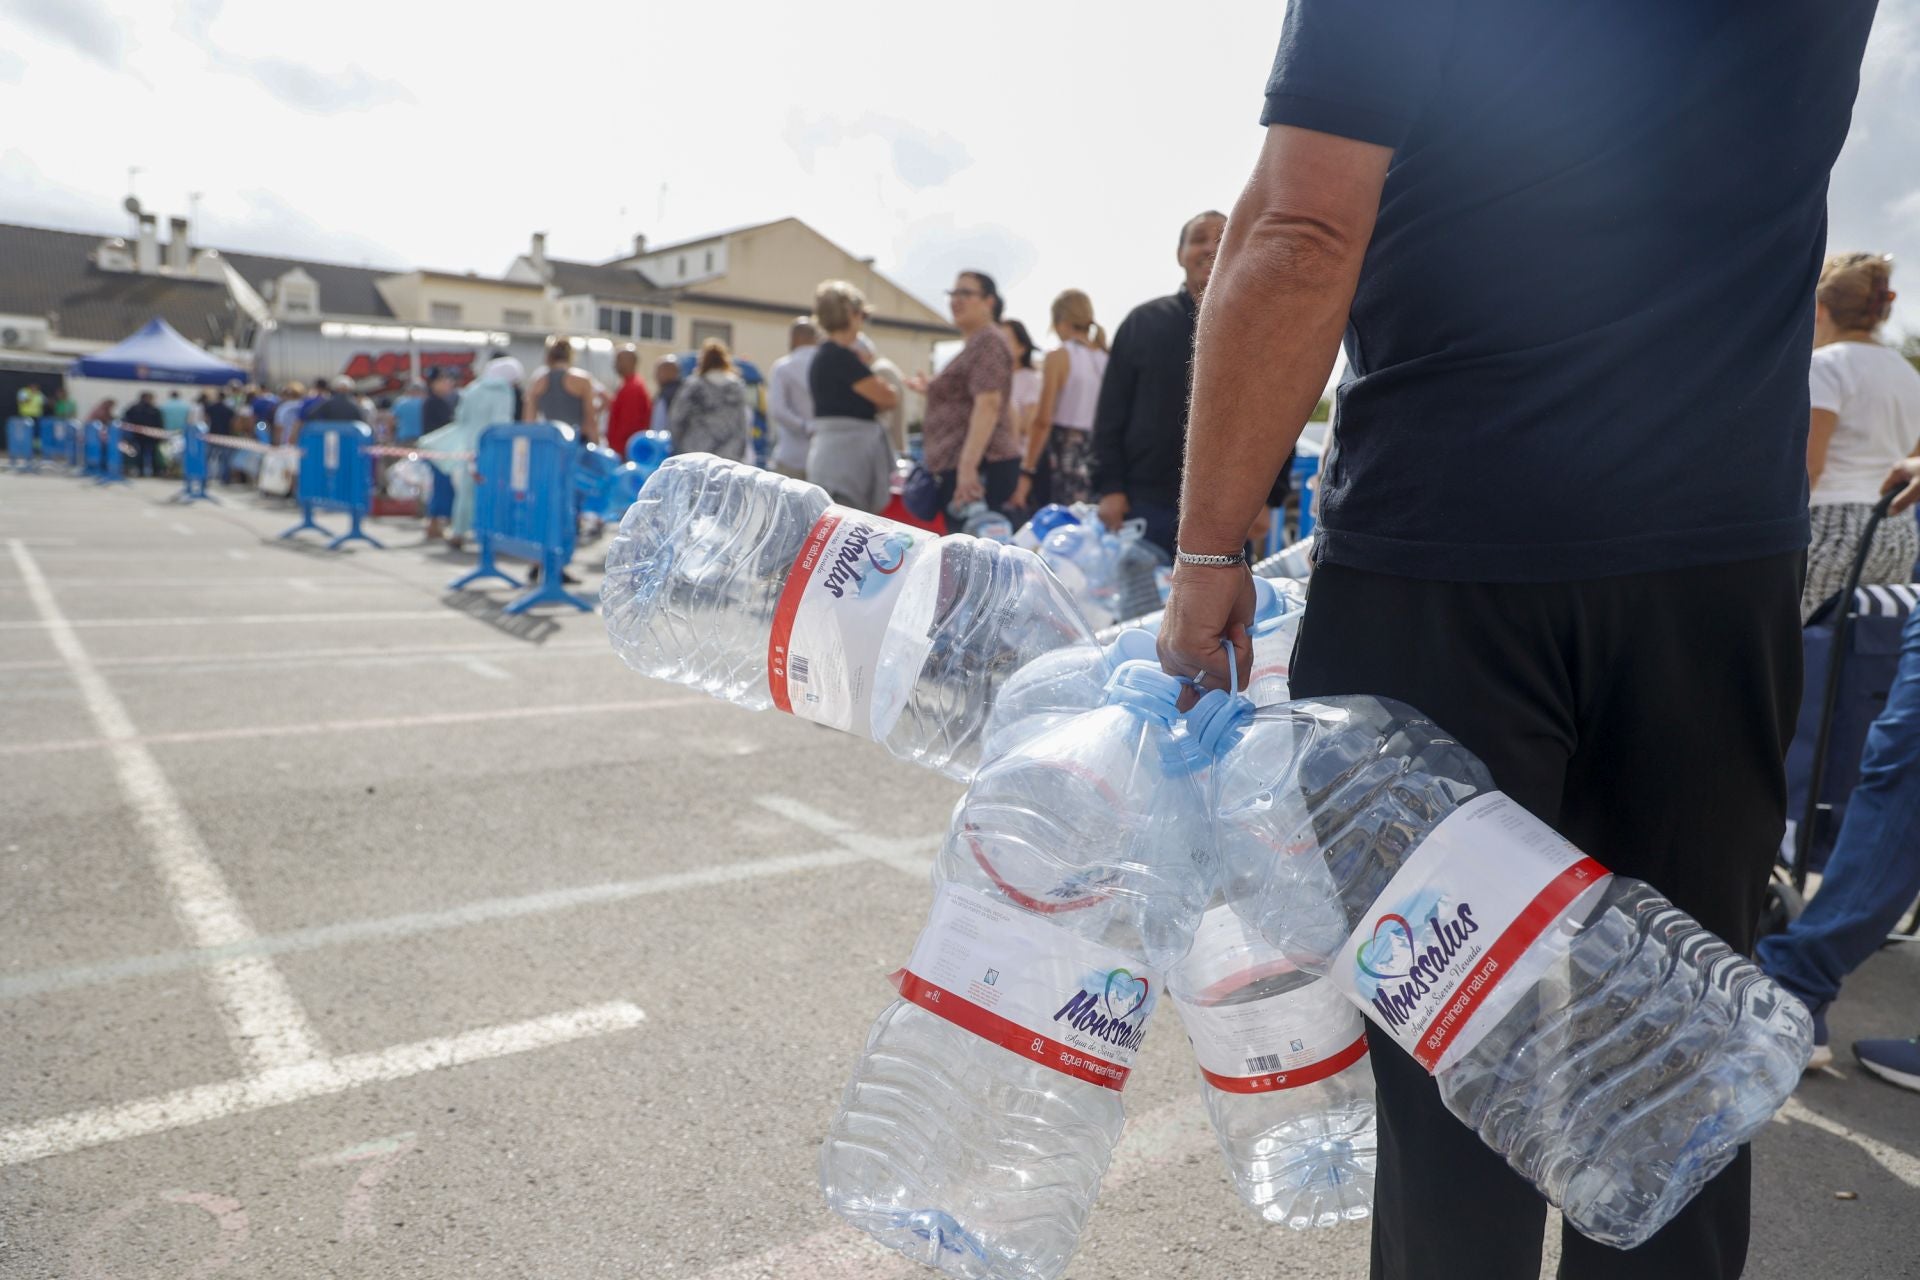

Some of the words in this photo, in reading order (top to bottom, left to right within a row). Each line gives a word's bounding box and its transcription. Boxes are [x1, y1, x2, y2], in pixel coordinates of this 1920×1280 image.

[802, 538, 822, 570] natural
[1371, 902, 1479, 1036] Monssalus
[1411, 1014, 1429, 1037] Agua
[1426, 1004, 1436, 1019] de
[1432, 980, 1455, 1006] Sierra
[1451, 944, 1483, 978] Nevada
[1426, 1023, 1446, 1050] agua
[1442, 990, 1471, 1030] mineral
[1467, 956, 1499, 993] natural
[1030, 1037, 1045, 1055] 8L
[1060, 1052, 1082, 1067] agua
[1053, 989, 1146, 1052] Monssalus
